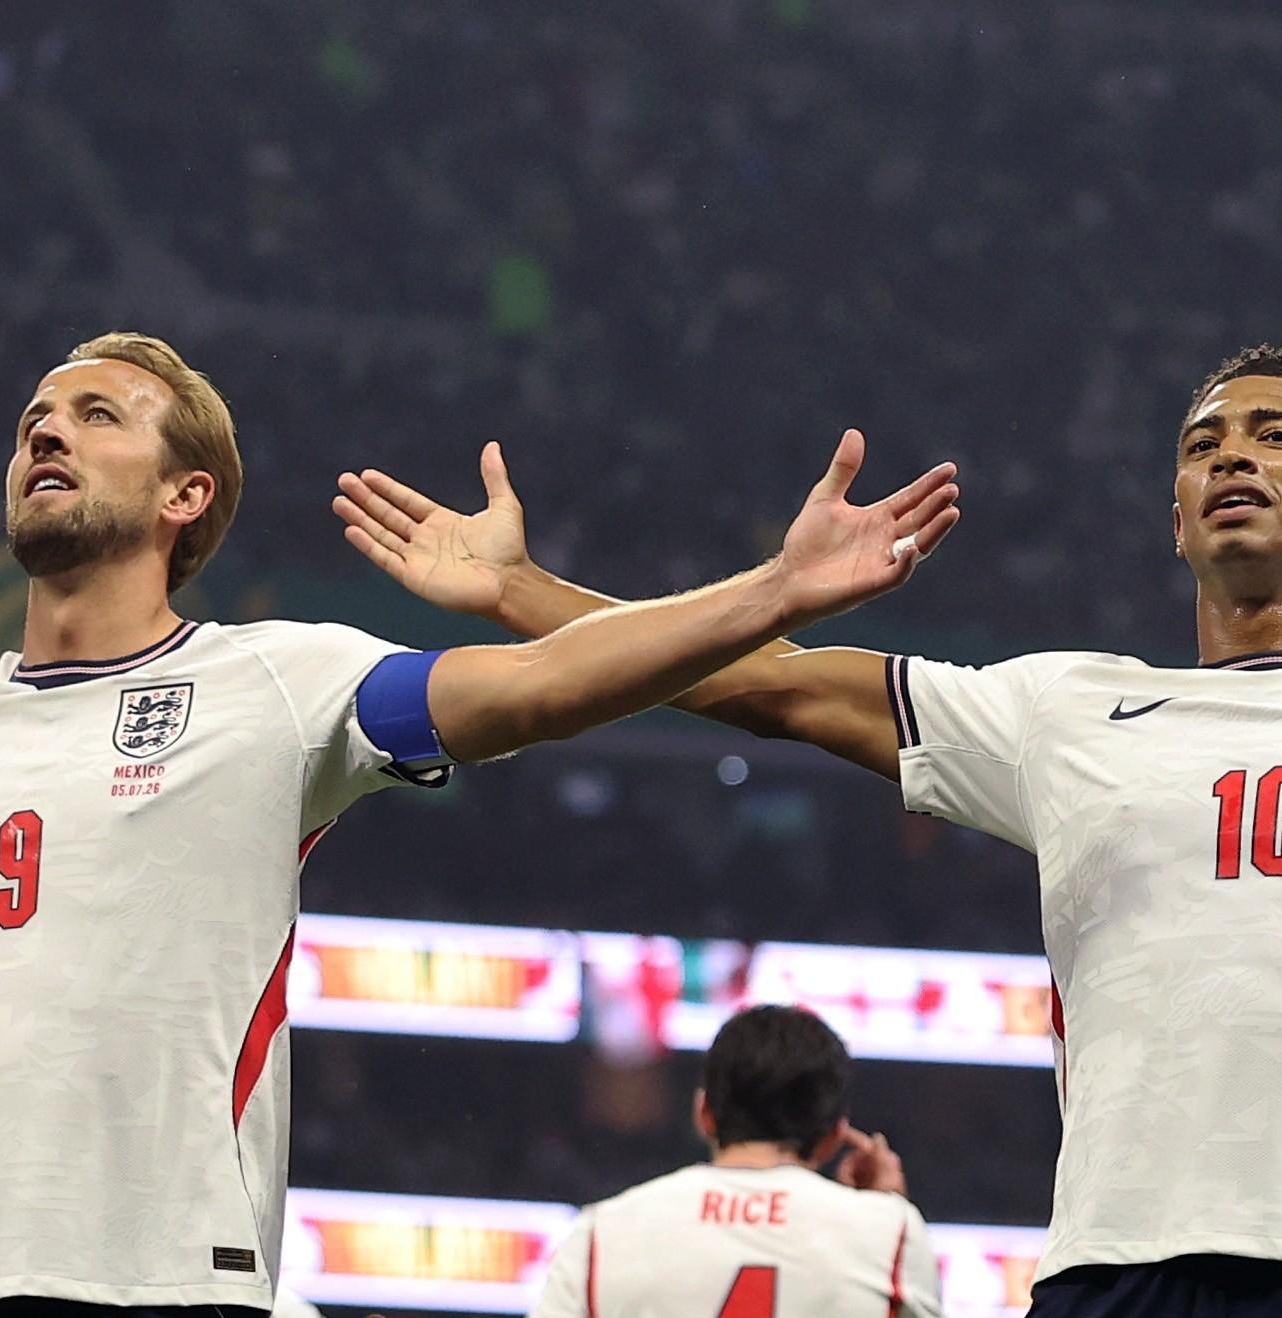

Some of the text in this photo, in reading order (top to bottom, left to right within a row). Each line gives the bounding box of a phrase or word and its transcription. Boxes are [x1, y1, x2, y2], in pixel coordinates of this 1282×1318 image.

[114, 764, 165, 778] MEXICO
[111, 782, 160, 796] 05.07.26
[700, 1190, 790, 1226] RICE
